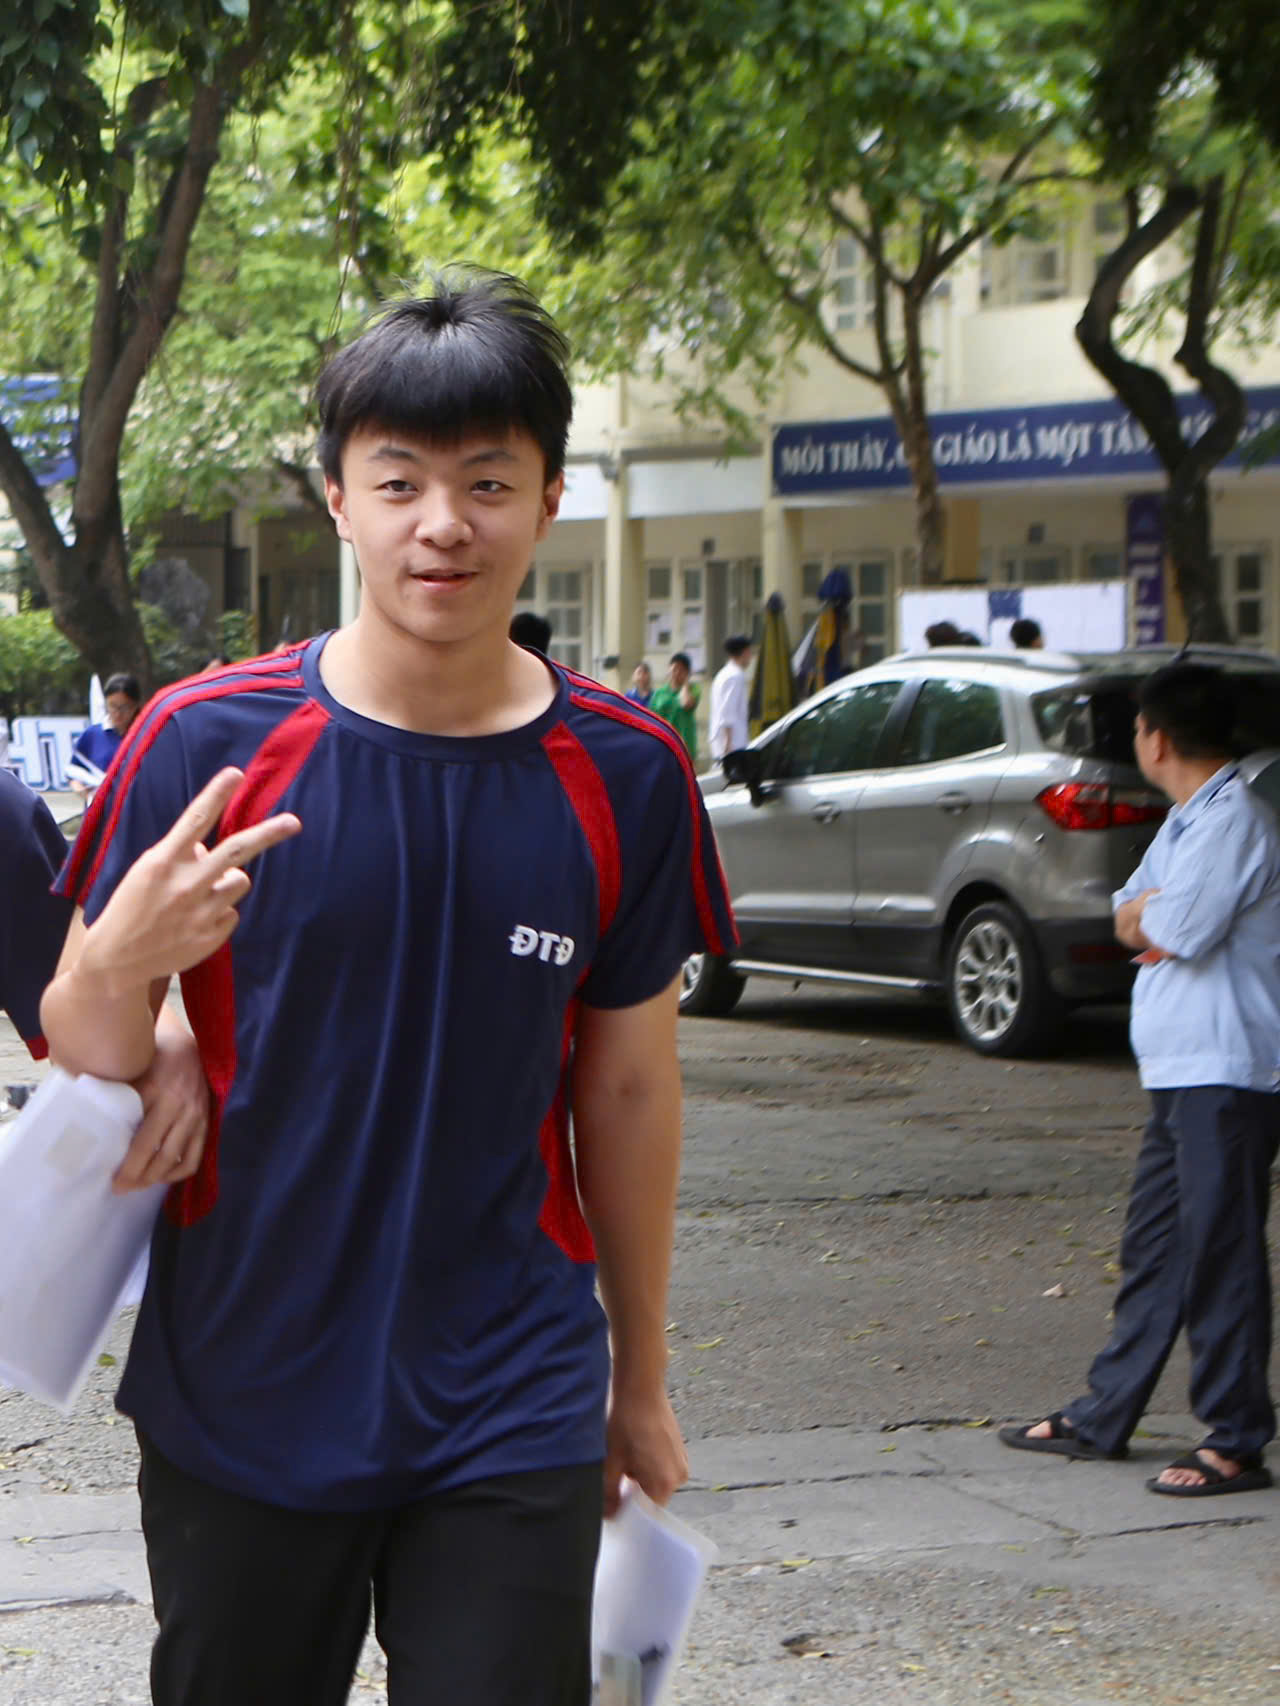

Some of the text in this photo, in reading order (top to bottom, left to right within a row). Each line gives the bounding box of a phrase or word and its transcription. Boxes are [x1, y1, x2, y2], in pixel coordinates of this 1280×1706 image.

[932, 424, 998, 467] GIÁO
[1034, 418, 1097, 468] MỘT
[508, 924, 576, 966] ĐTĐ
